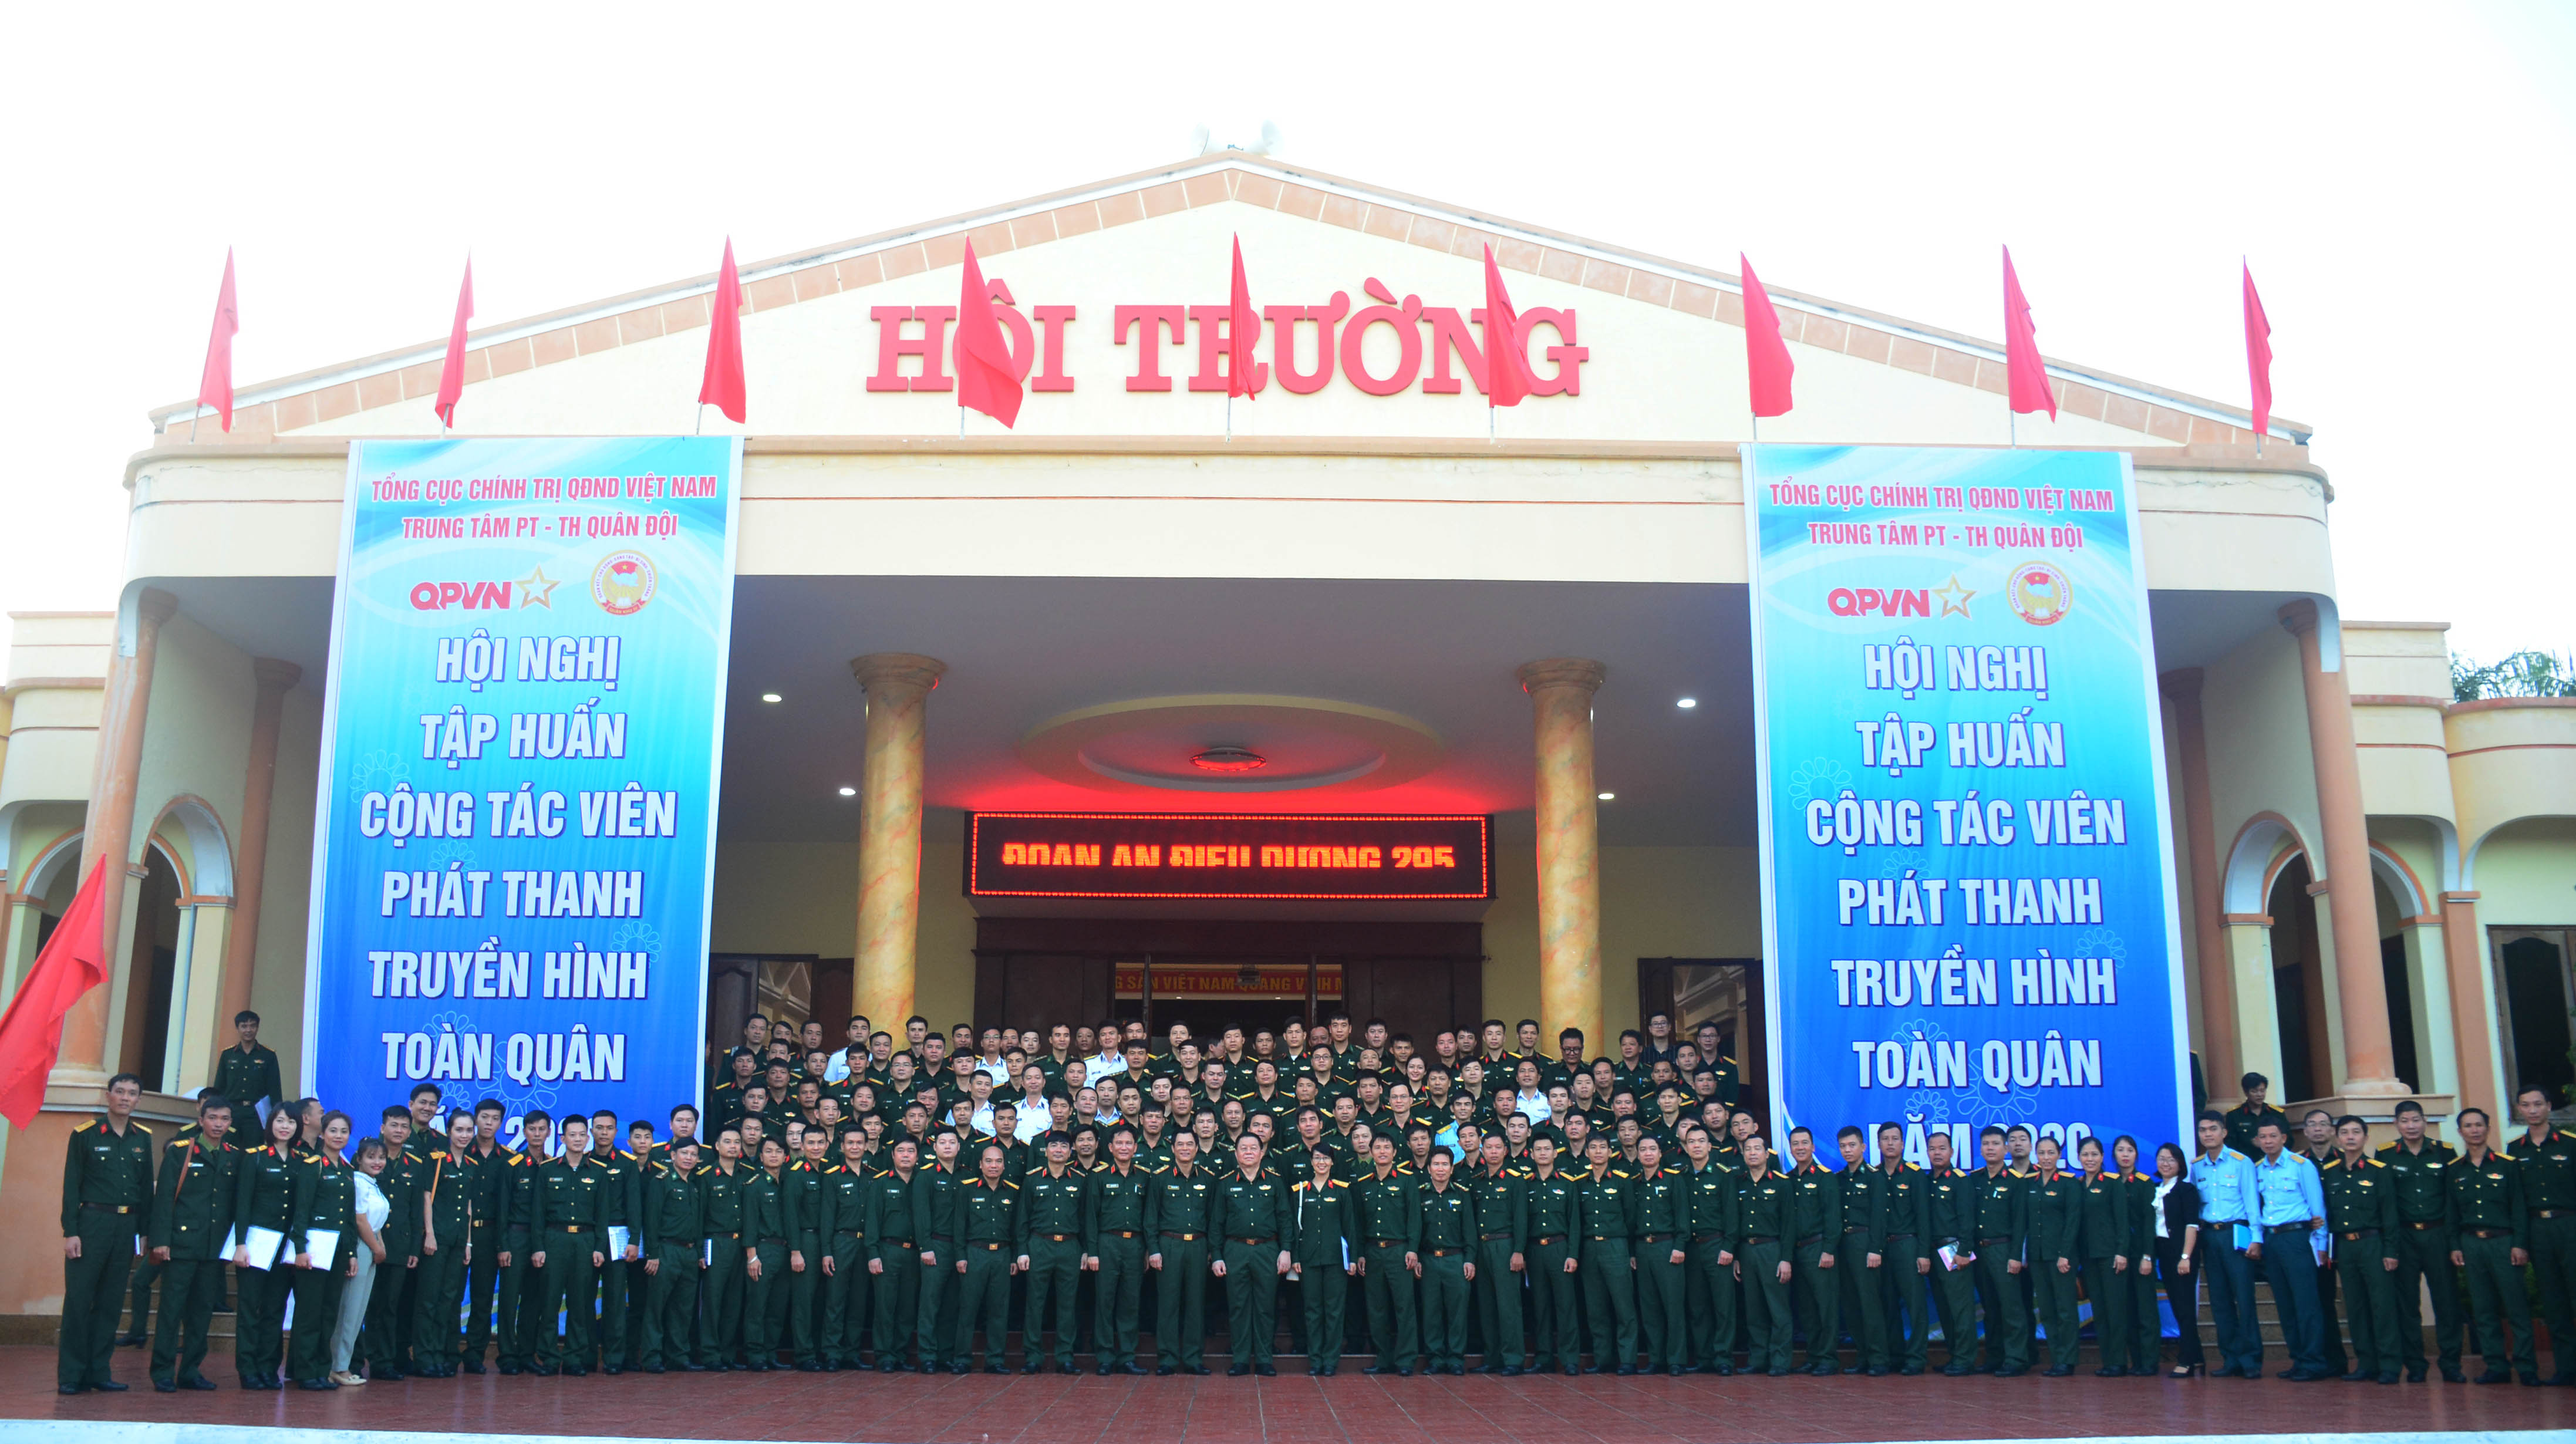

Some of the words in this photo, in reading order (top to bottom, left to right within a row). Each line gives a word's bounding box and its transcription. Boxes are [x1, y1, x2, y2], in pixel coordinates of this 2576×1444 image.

[1114, 276, 1589, 396] TRƯỜNG
[373, 472, 420, 500] TỔNG
[426, 480, 463, 506] CỤC
[470, 474, 527, 499] CHÍNH
[534, 478, 562, 503] TRỊ
[568, 478, 620, 500] QĐND
[626, 472, 668, 502] VIỆT
[672, 477, 717, 497] NAM
[1770, 476, 1820, 505] TỔNG
[1826, 485, 1864, 511] CỤC
[1871, 481, 1928, 506] CHÍNH
[1934, 488, 1963, 512] TRỊ
[1969, 488, 2019, 510] QĐND
[2025, 484, 2064, 514] VIỆT
[2071, 490, 2113, 510] NAM
[403, 518, 464, 538] TRUNG
[471, 513, 511, 538] TÂM
[516, 517, 540, 537] PT
[559, 517, 582, 537] TH
[588, 511, 640, 538] QUÂN
[646, 511, 678, 541] ĐỘI
[1809, 523, 1872, 544] TRUNG
[1877, 521, 1918, 545] TÂM
[1924, 525, 1946, 545] PT
[1965, 527, 1988, 546] TH
[1994, 522, 2045, 549] QUÂN
[2051, 523, 2083, 552] ĐỘI
[410, 582, 512, 610] QPVN
[1828, 588, 1931, 617] QPVN
[436, 628, 506, 691] HỘI
[517, 636, 620, 690] NGHỊ
[1864, 636, 1934, 699] HỘI
[1946, 646, 2047, 700] NGHỊ
[420, 705, 497, 769] TẬP
[509, 697, 626, 758] HUẤN
[1856, 712, 1935, 777] TẬP
[1948, 707, 2065, 767] HUẤN
[360, 782, 474, 848] CỘNG
[486, 781, 565, 838] TÁC
[579, 781, 677, 837] VIÊN
[1806, 790, 1923, 856] CỘNG
[1934, 790, 2015, 846] TÁC
[2026, 790, 2126, 845] VIÊN
[380, 861, 491, 917] PHÁT
[501, 871, 643, 917] THANH
[1838, 869, 1947, 926] PHÁT
[1959, 878, 2102, 925] THANH
[367, 936, 530, 998] TRUYỀN
[542, 942, 648, 999] HÌNH
[1163, 973, 1196, 993] VIỆT
[1199, 977, 1235, 991] NAM
[1831, 944, 1998, 1007] TRUYỀN
[2011, 949, 2116, 1005] HÌNH
[381, 1023, 493, 1081] TOÀN
[505, 1023, 625, 1087] QUÂN
[1852, 1030, 1968, 1089] TOÀN
[1982, 1030, 2102, 1093] QUÂN
